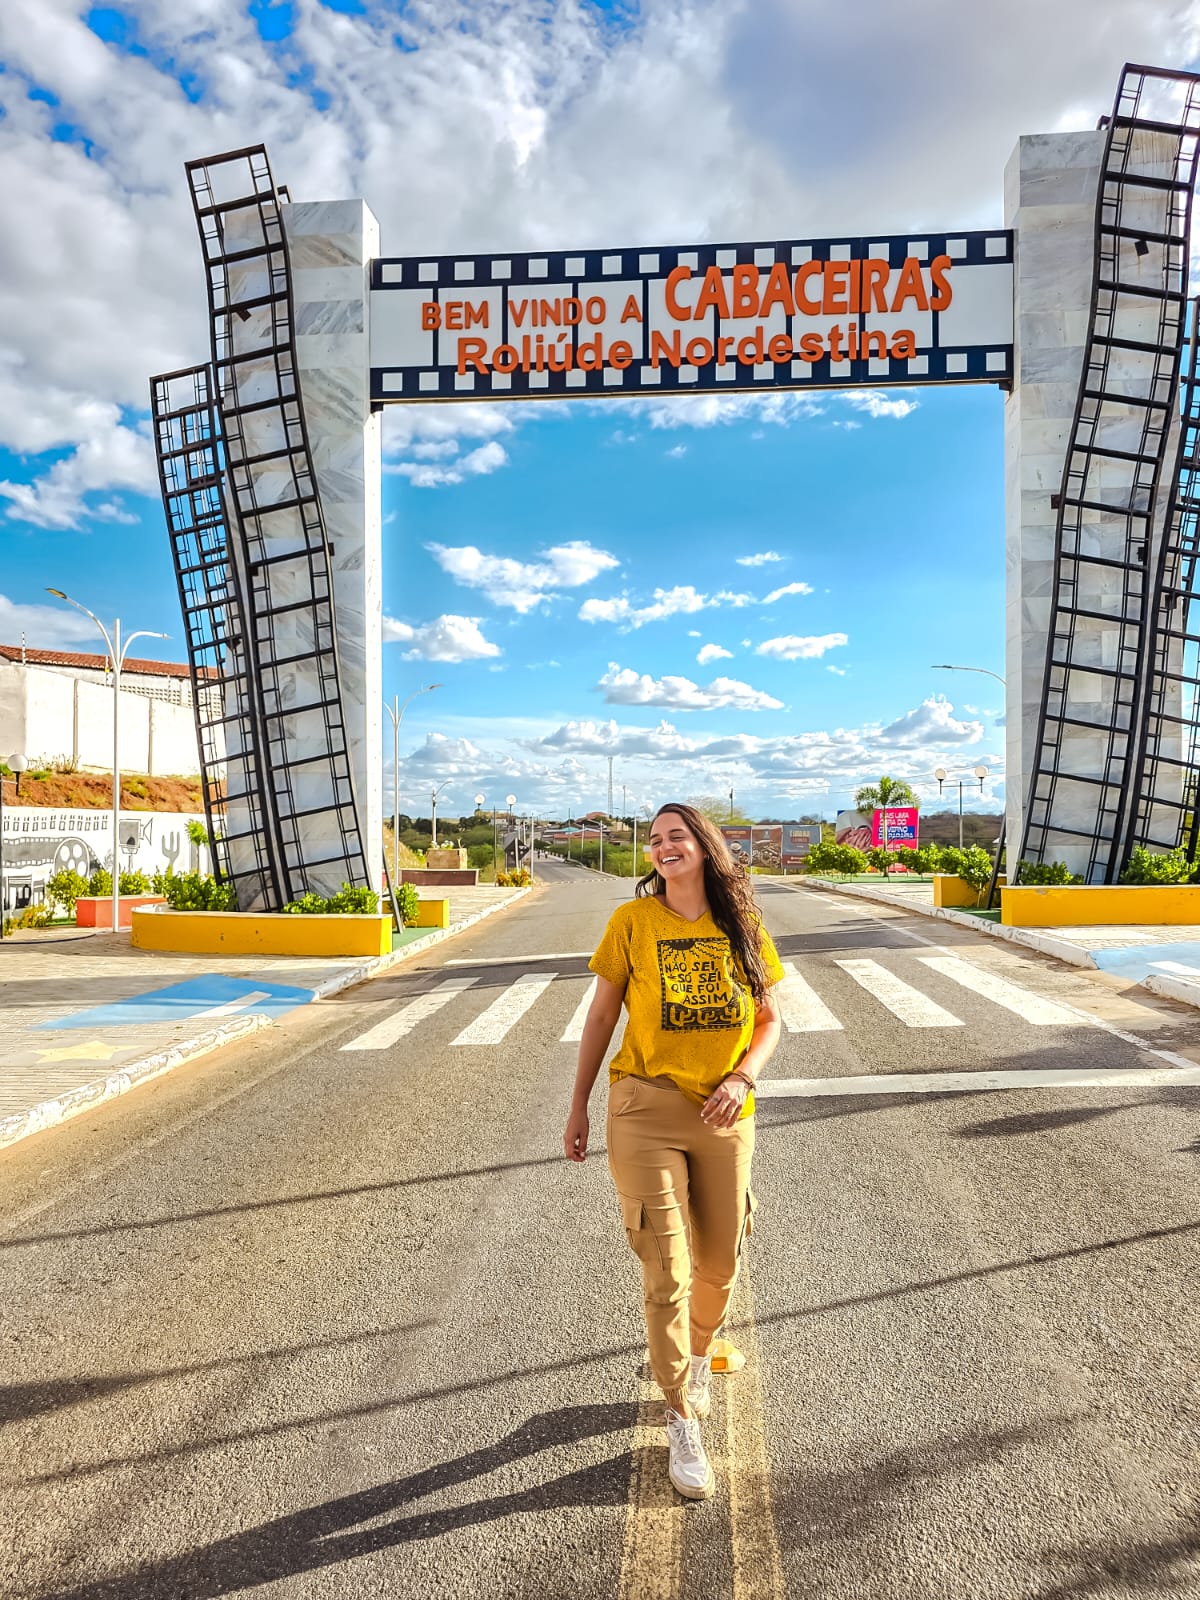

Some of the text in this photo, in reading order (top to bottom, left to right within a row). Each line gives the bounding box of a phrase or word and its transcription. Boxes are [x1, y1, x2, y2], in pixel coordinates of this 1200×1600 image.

[422, 255, 953, 331] BEM VINDO A CABACEIRAS
[457, 322, 917, 376] Roliúde Nordestina
[664, 961, 687, 973] NÃO
[678, 972, 722, 983] SÓ SEI
[671, 983, 720, 994] QUE FOI
[682, 992, 728, 1005] ASSIM
